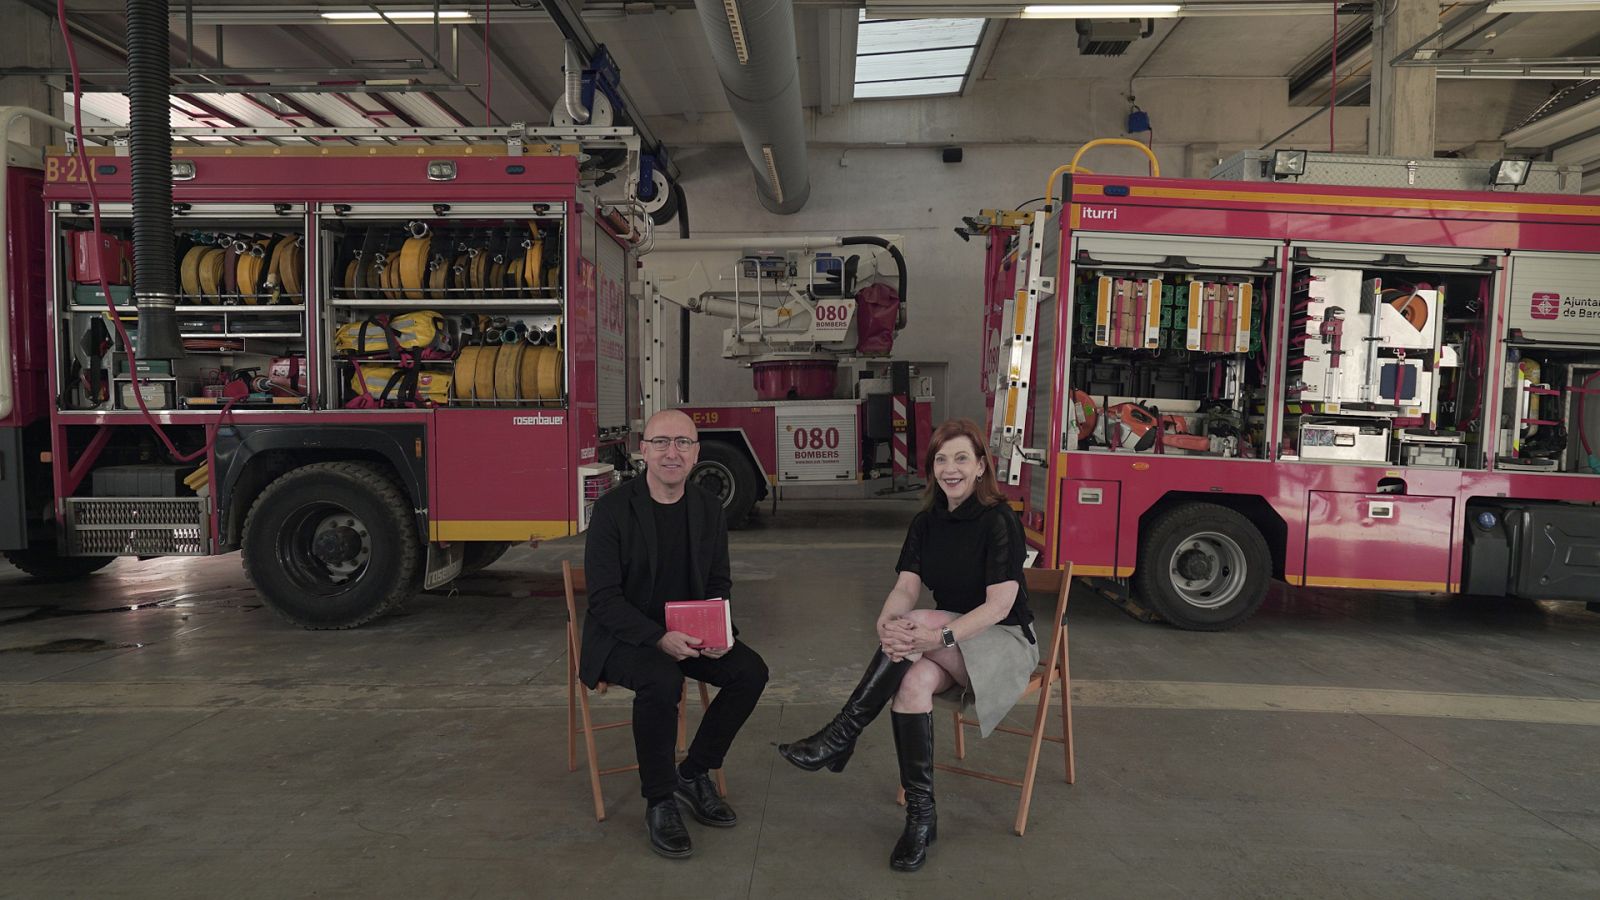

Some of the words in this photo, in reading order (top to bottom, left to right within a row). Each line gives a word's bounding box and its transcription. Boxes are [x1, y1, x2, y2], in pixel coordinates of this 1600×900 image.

[1082, 206, 1118, 220] iturri
[1563, 296, 1600, 308] Ajunta
[815, 305, 848, 321] 080
[1563, 308, 1576, 318] de
[513, 411, 564, 426] rosenbauer
[793, 427, 840, 450] 080
[794, 450, 840, 459] BOMBERS
